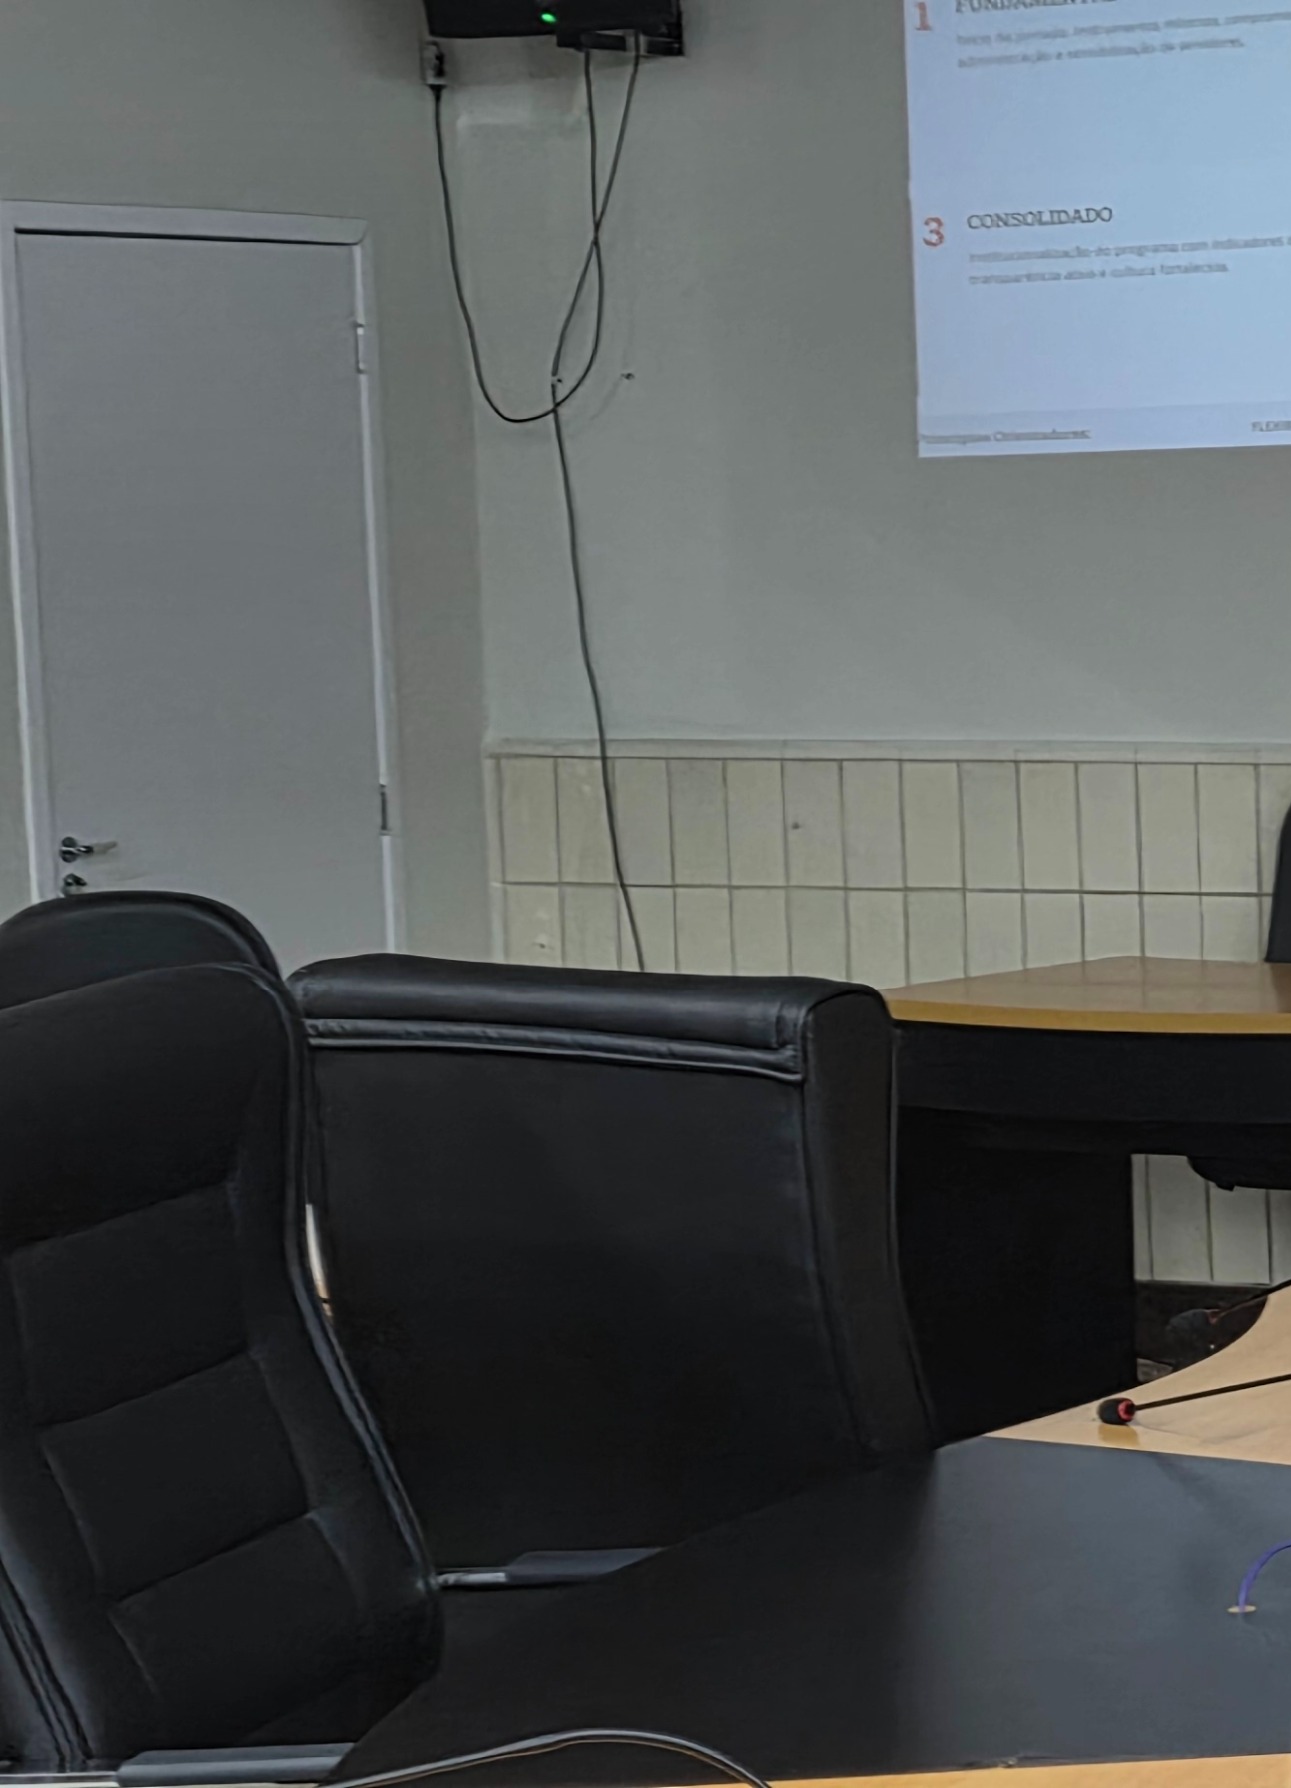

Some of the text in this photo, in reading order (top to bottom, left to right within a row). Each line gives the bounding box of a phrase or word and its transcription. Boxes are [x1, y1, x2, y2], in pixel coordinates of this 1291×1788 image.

[914, 1, 932, 31] 1
[922, 216, 945, 248] 3
[966, 206, 1113, 230] CONSOLIDADO
